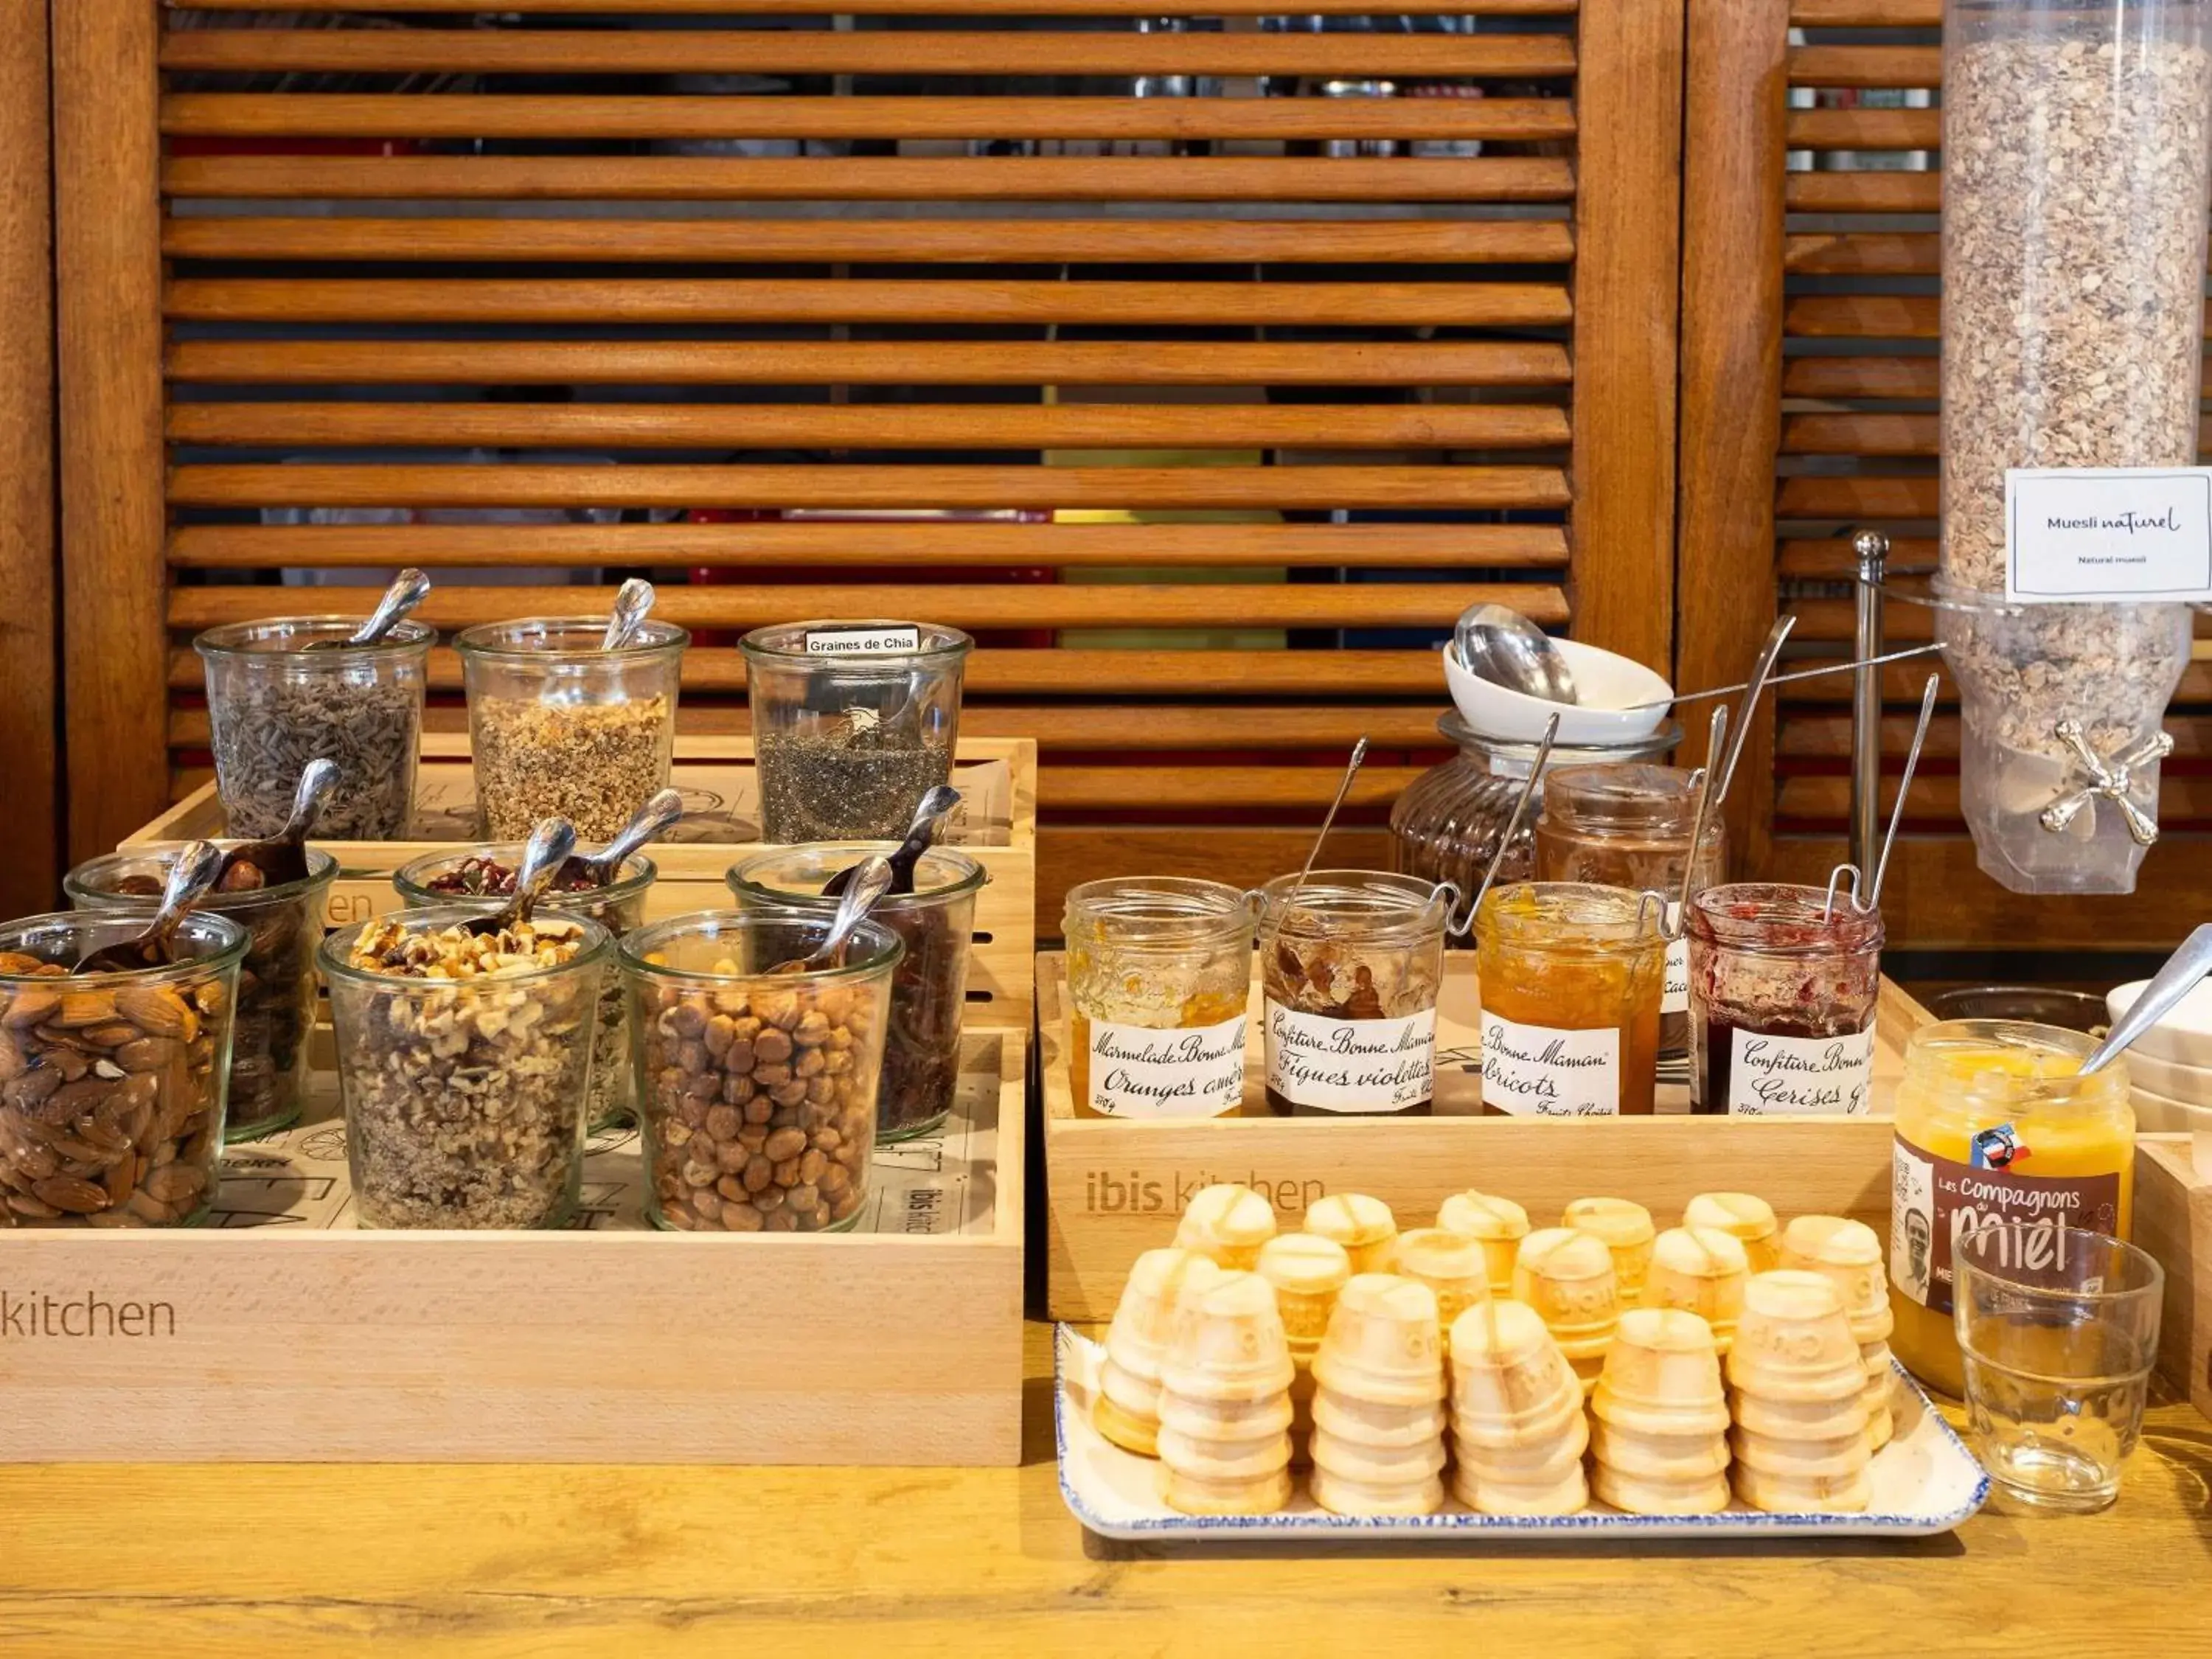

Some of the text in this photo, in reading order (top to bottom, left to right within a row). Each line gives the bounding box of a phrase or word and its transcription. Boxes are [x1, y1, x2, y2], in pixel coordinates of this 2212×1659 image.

[2047, 507, 2181, 535] Muesli naturel
[2078, 556, 2113, 564] Natural
[810, 637, 914, 652] Graines de Chia
[1092, 1032, 1178, 1065] Marmelade
[1178, 1034, 1226, 1063] Bonne
[1273, 1010, 1327, 1051] Confiture
[1329, 1026, 1388, 1055] Bonne
[1487, 1025, 1606, 1068] Bonne Maman
[1278, 1048, 1431, 1086] Figues violettes
[1744, 1040, 1863, 1075] Confiture Bonn
[1104, 1068, 1197, 1107] Oranges
[1482, 1057, 1561, 1098] bricots
[1751, 1077, 1841, 1107] Cerises
[1086, 1171, 1163, 1212] ibis
[1938, 1177, 1957, 1193] Les
[1960, 1178, 2081, 1217] Compagnons
[1935, 1267, 1953, 1281] MIE
[1, 1290, 175, 1337] kitchen
